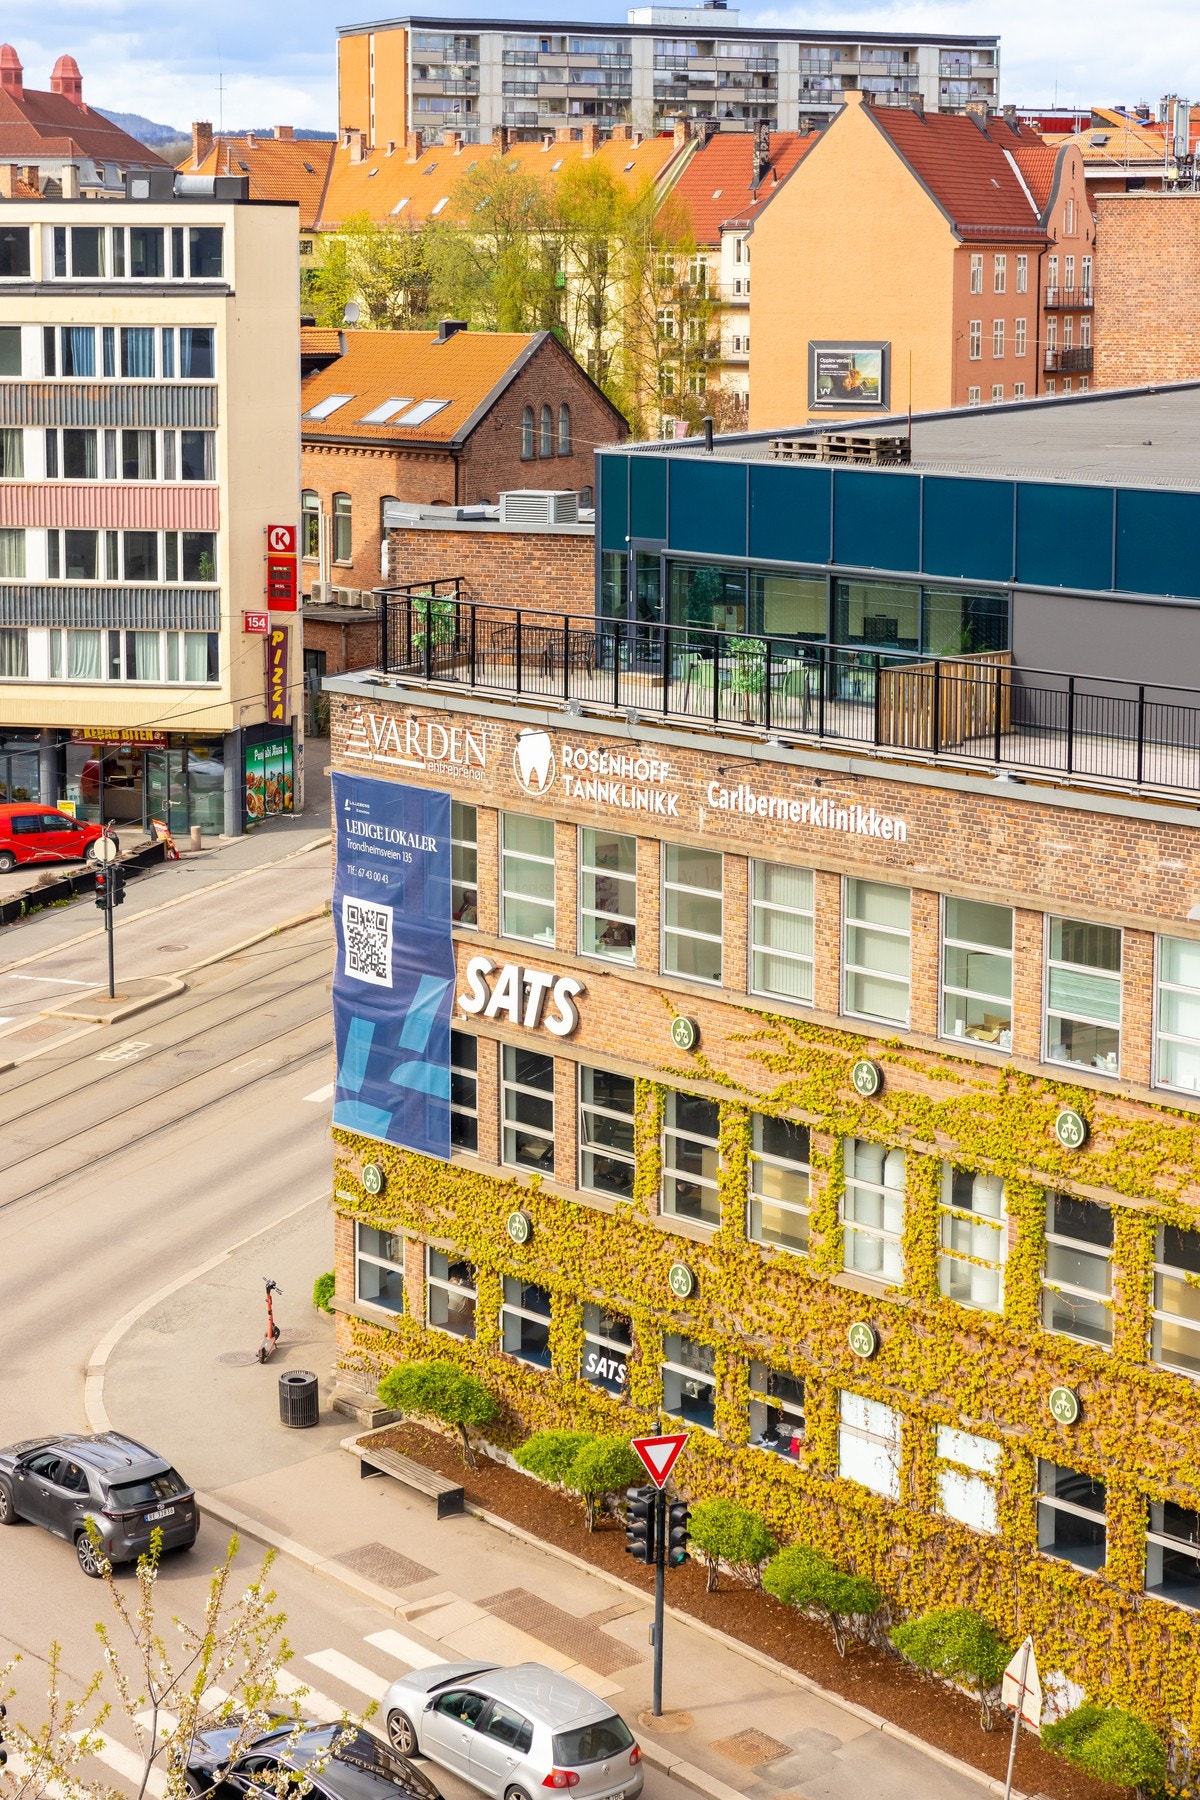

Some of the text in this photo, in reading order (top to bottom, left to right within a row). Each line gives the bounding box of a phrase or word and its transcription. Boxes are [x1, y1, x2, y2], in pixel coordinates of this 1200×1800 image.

[273, 530, 289, 549] K
[247, 617, 266, 628] 154
[272, 630, 285, 719] PIZZA
[83, 728, 154, 741] KEBAB BITEN
[367, 713, 487, 768] VARDEN
[428, 761, 486, 780] entreprenør
[561, 745, 671, 784] ROSENHOFF
[561, 774, 680, 817] TANNKLINIKK
[707, 781, 908, 842] Carlbernerklinikken
[345, 818, 439, 853] LEDIGE LOKALER
[346, 838, 413, 864] Trondheimsveien 135
[357, 867, 365, 878] 67
[365, 870, 373, 880] 43
[373, 871, 382, 882] 00
[381, 874, 389, 884] 43
[457, 956, 586, 1036] SATS
[585, 1353, 628, 1384] SATS
